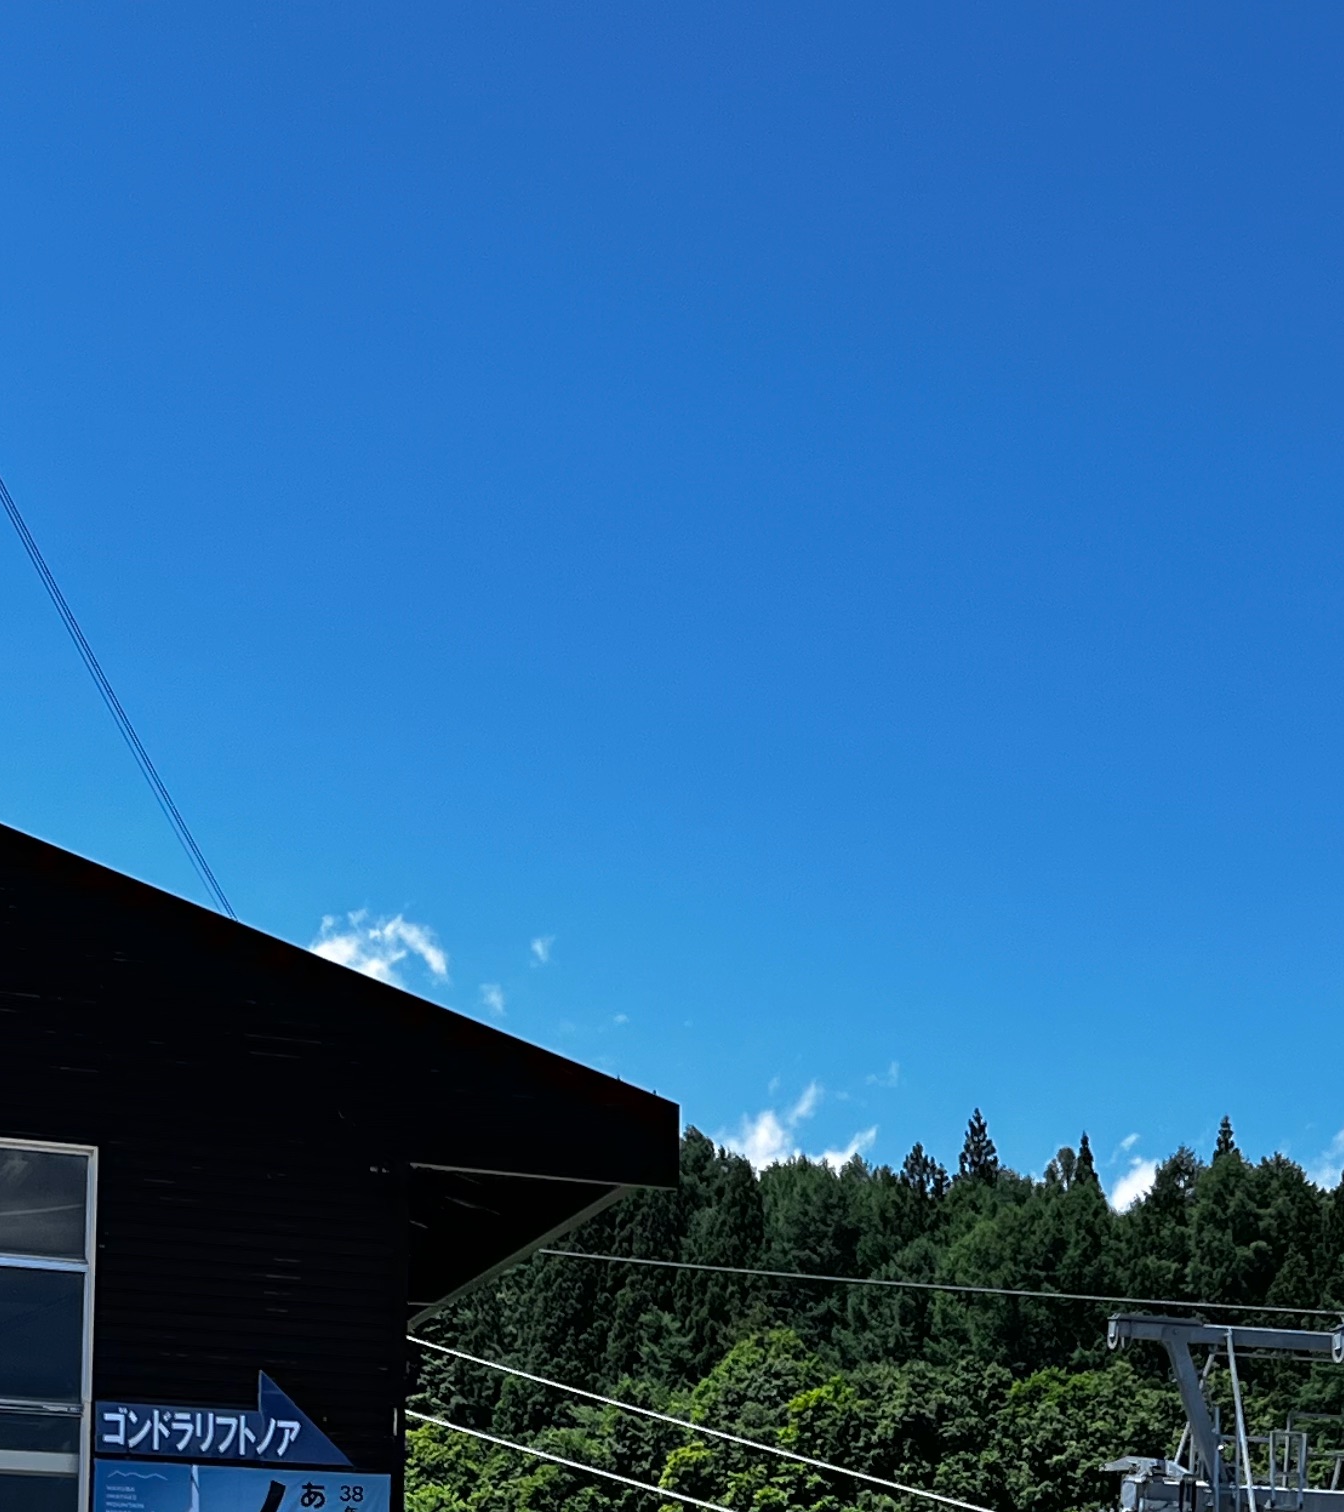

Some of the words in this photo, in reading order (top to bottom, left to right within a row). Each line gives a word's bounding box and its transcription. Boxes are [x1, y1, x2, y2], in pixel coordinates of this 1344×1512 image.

[102, 1406, 302, 1456] ゴンドラリフトノア
